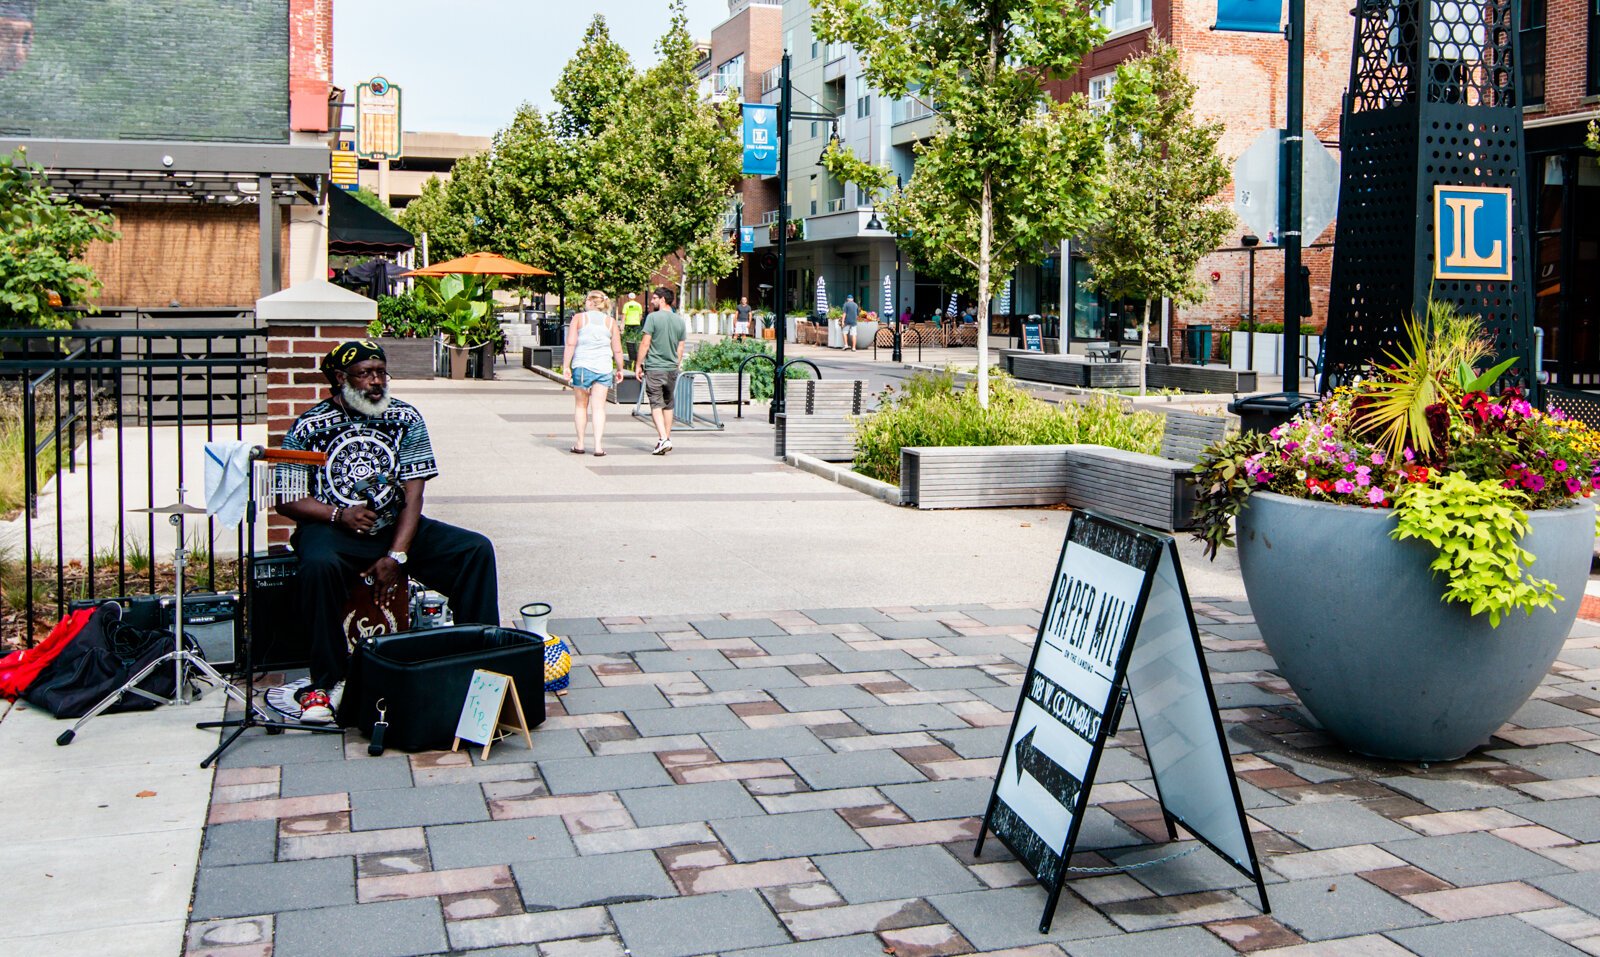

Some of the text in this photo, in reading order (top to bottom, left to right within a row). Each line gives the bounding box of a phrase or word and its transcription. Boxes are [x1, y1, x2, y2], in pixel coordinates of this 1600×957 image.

[1048, 573, 1097, 650] PAPER
[1064, 650, 1070, 659] ON
[1077, 657, 1093, 673] LANDING
[1031, 676, 1045, 700] 118
[1043, 682, 1055, 709] W.
[1052, 691, 1092, 737] COLUMBIA
